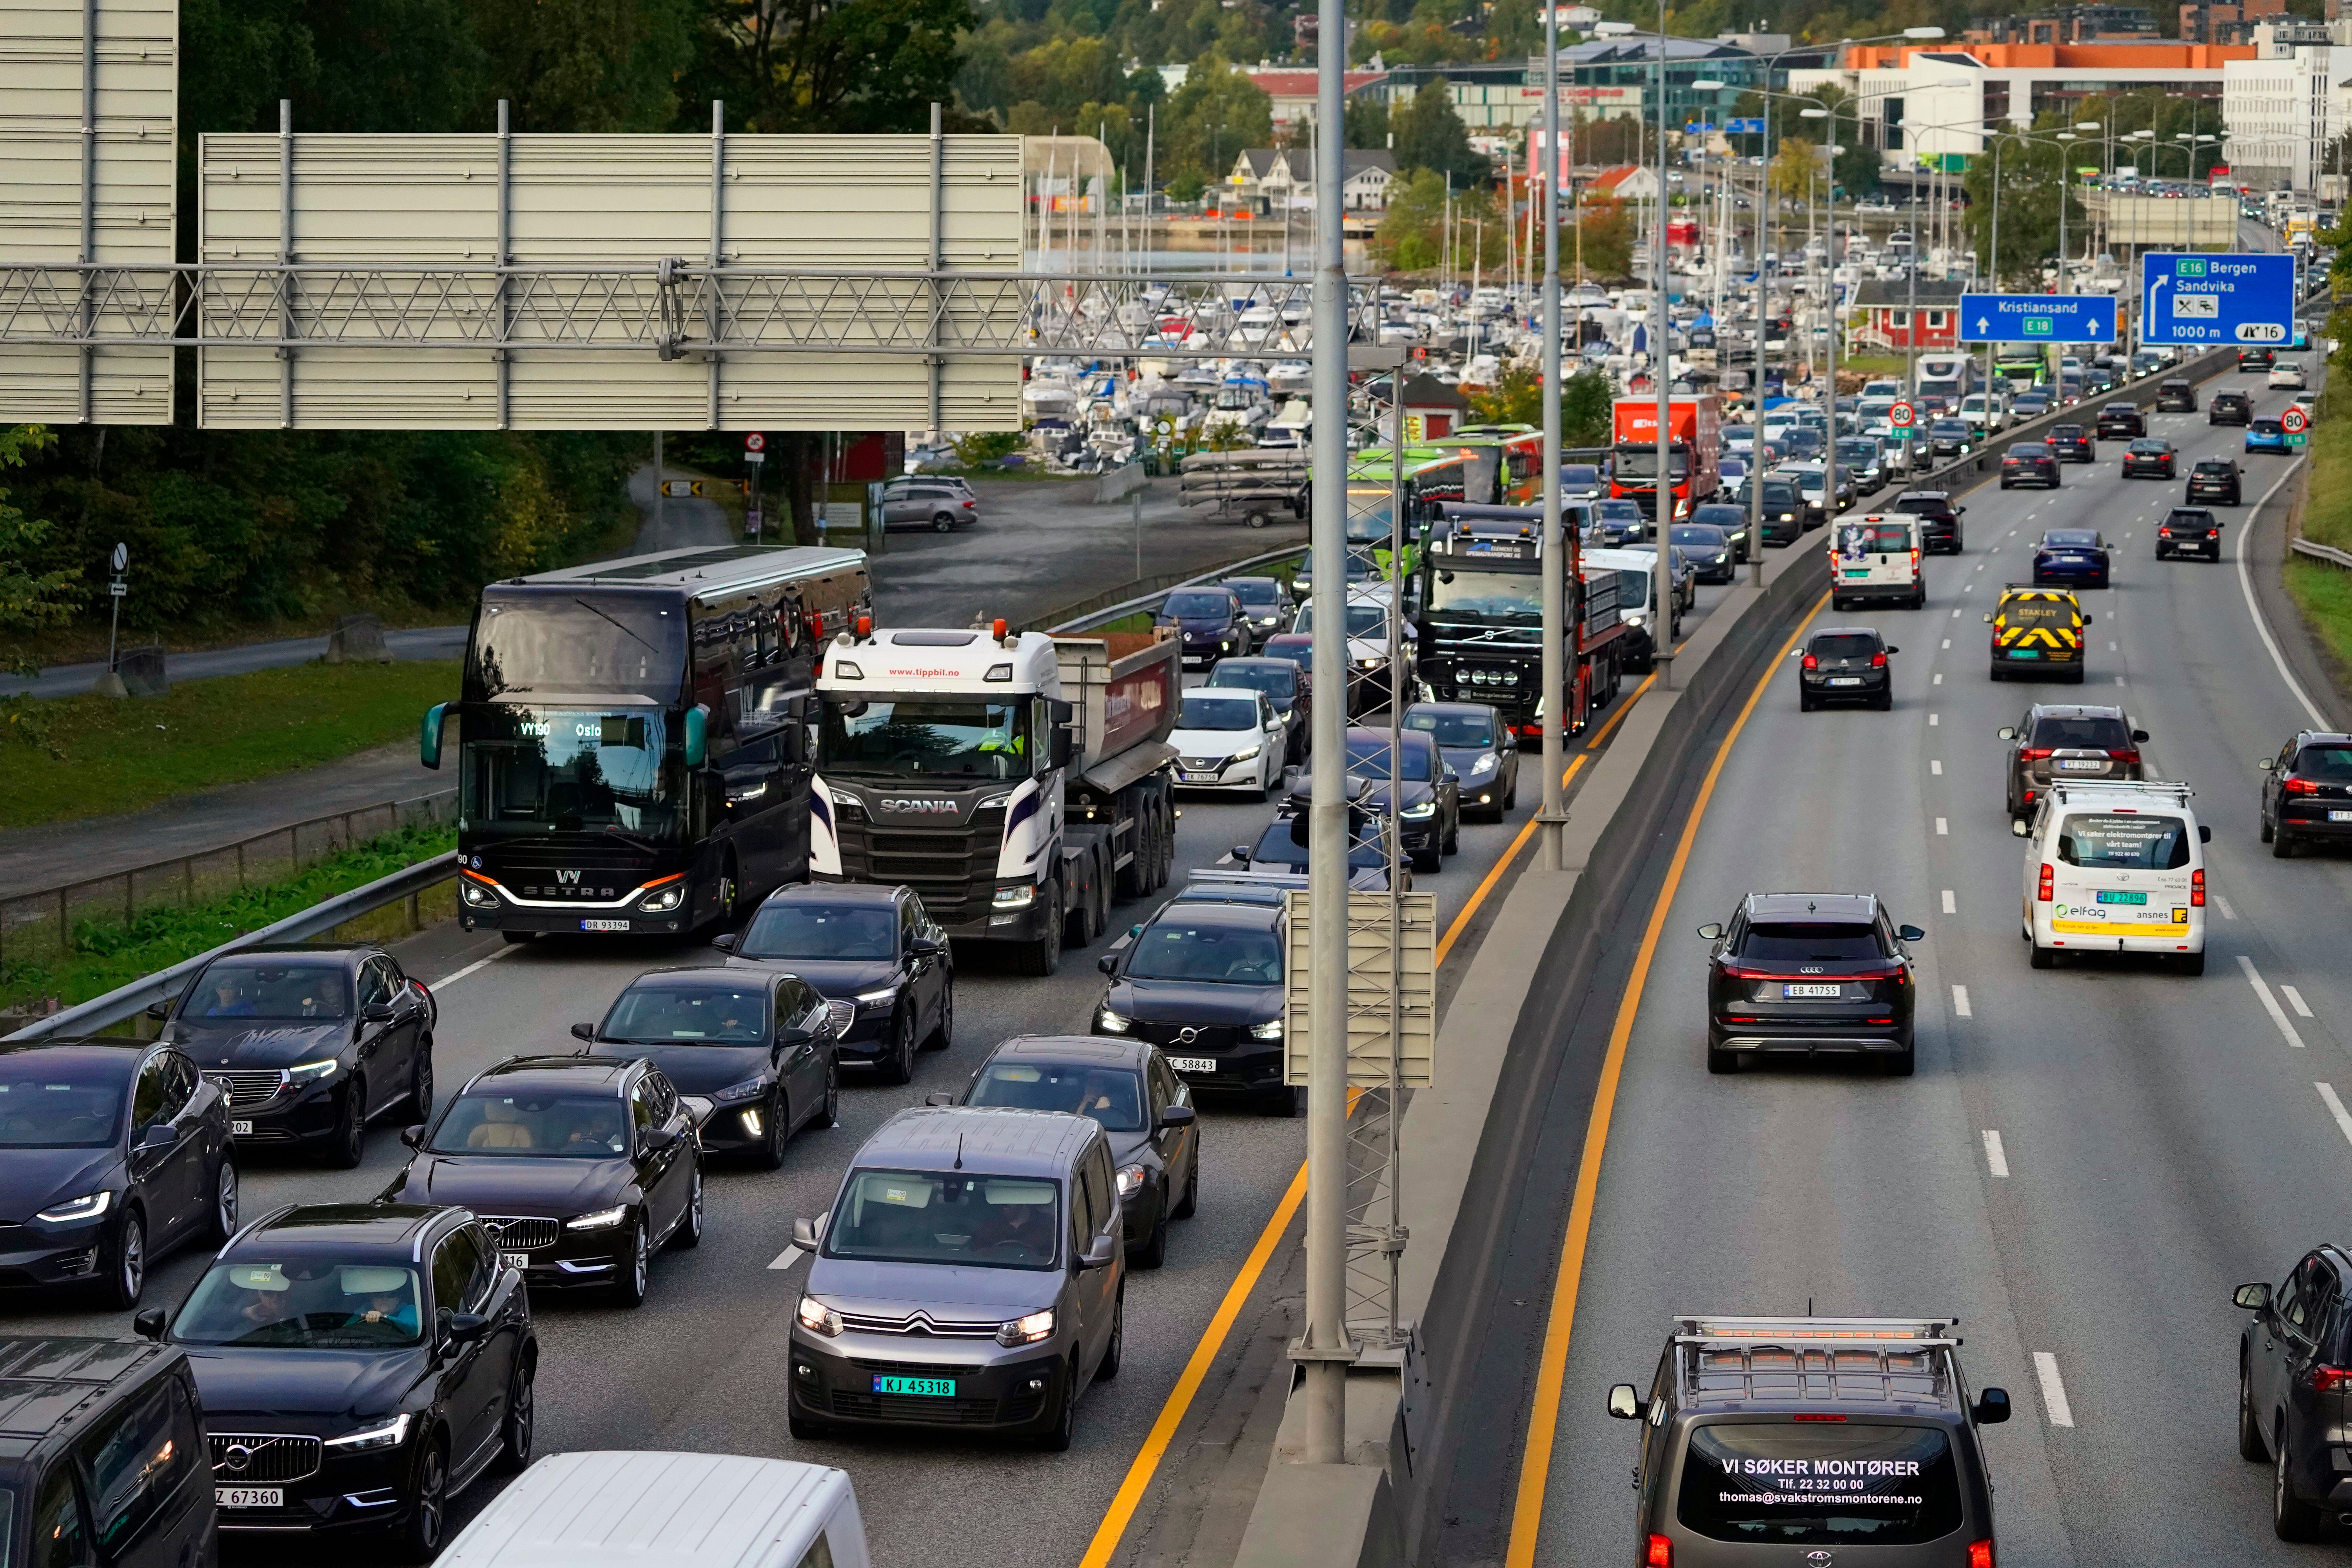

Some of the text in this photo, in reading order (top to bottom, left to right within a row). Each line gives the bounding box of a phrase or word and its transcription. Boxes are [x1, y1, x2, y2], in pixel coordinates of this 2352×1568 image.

[2181, 263, 2201, 272] E 16
[2211, 262, 2256, 276] Bergen
[2176, 280, 2234, 292] Sandvika
[1999, 301, 2077, 313] Kristiansand
[2027, 321, 2048, 330] E 18
[2172, 326, 2220, 338] 1000 m
[2265, 327, 2278, 338] 16
[1895, 409, 1909, 420] 80
[2287, 416, 2302, 426] 80
[2019, 608, 2057, 617] STANLEY
[889, 669, 959, 677] www.tippbil.no
[521, 723, 601, 736] VY190 Oslo
[880, 799, 958, 813] SCANIA
[458, 854, 467, 864] 90
[524, 886, 614, 896] SETRA
[2070, 906, 2106, 919] elfag
[602, 921, 628, 929] 93394
[1793, 986, 1836, 995] EB 41755
[1182, 1060, 1212, 1070] 58843
[886, 1379, 949, 1394] KJ 45318
[1722, 1459, 1920, 1476] VI SØKER MONTØRER
[1778, 1479, 1864, 1490] Tlf. 22 32 00 00
[216, 1490, 278, 1504] Z 67360
[1719, 1492, 1922, 1504] thomas@svakstromsmontorene.no
